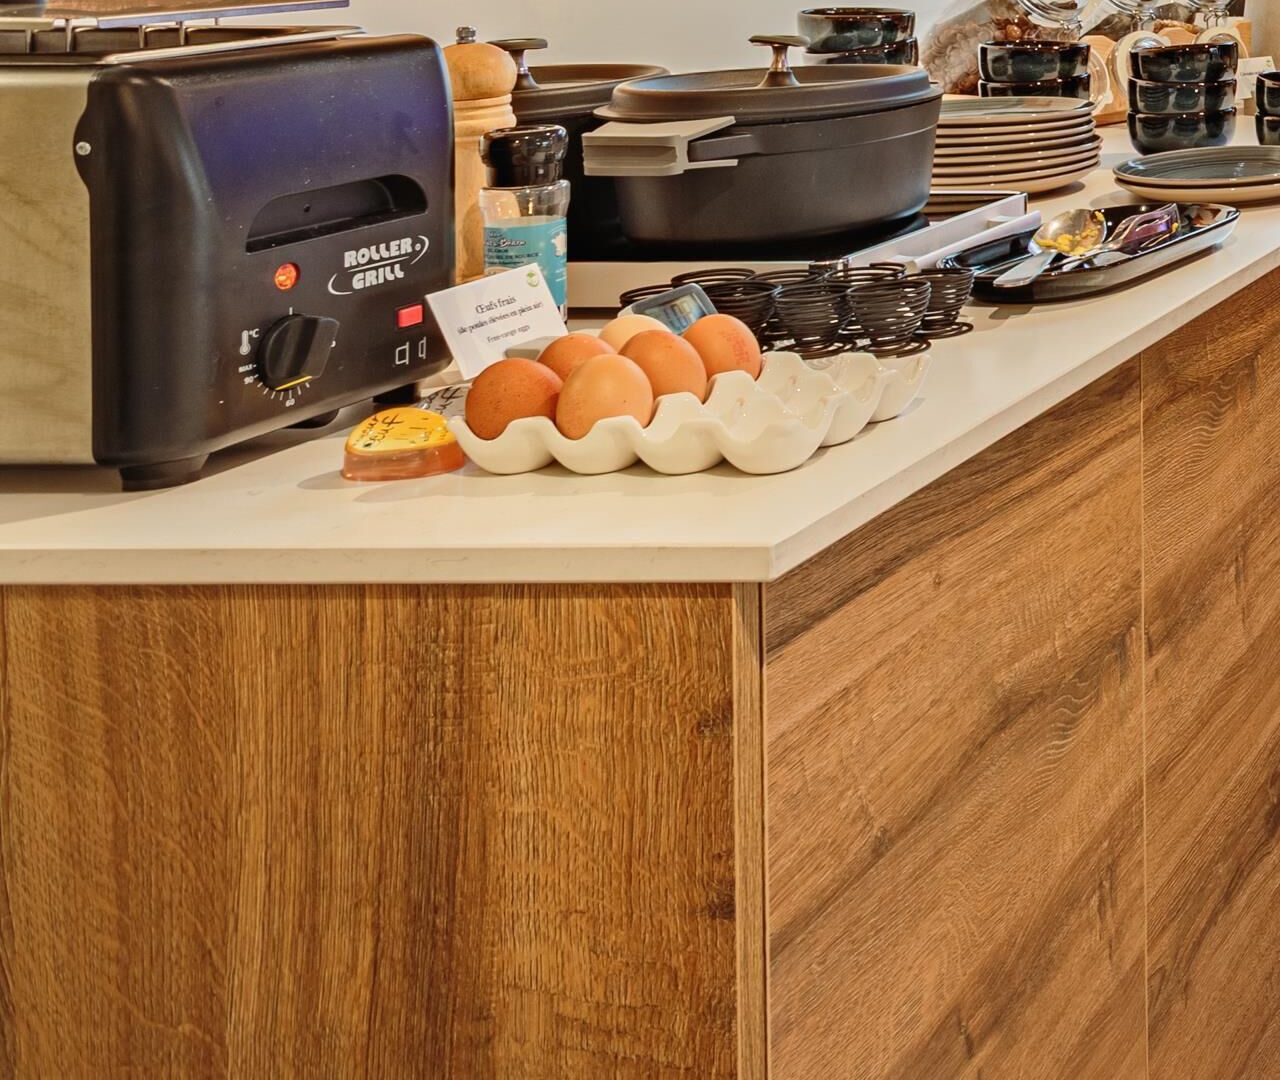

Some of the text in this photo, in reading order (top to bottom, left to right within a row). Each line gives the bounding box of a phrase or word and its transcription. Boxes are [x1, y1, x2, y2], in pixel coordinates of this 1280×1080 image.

[344, 237, 413, 268] ROLLER
[352, 263, 405, 290] GRILL
[498, 295, 516, 309] frais
